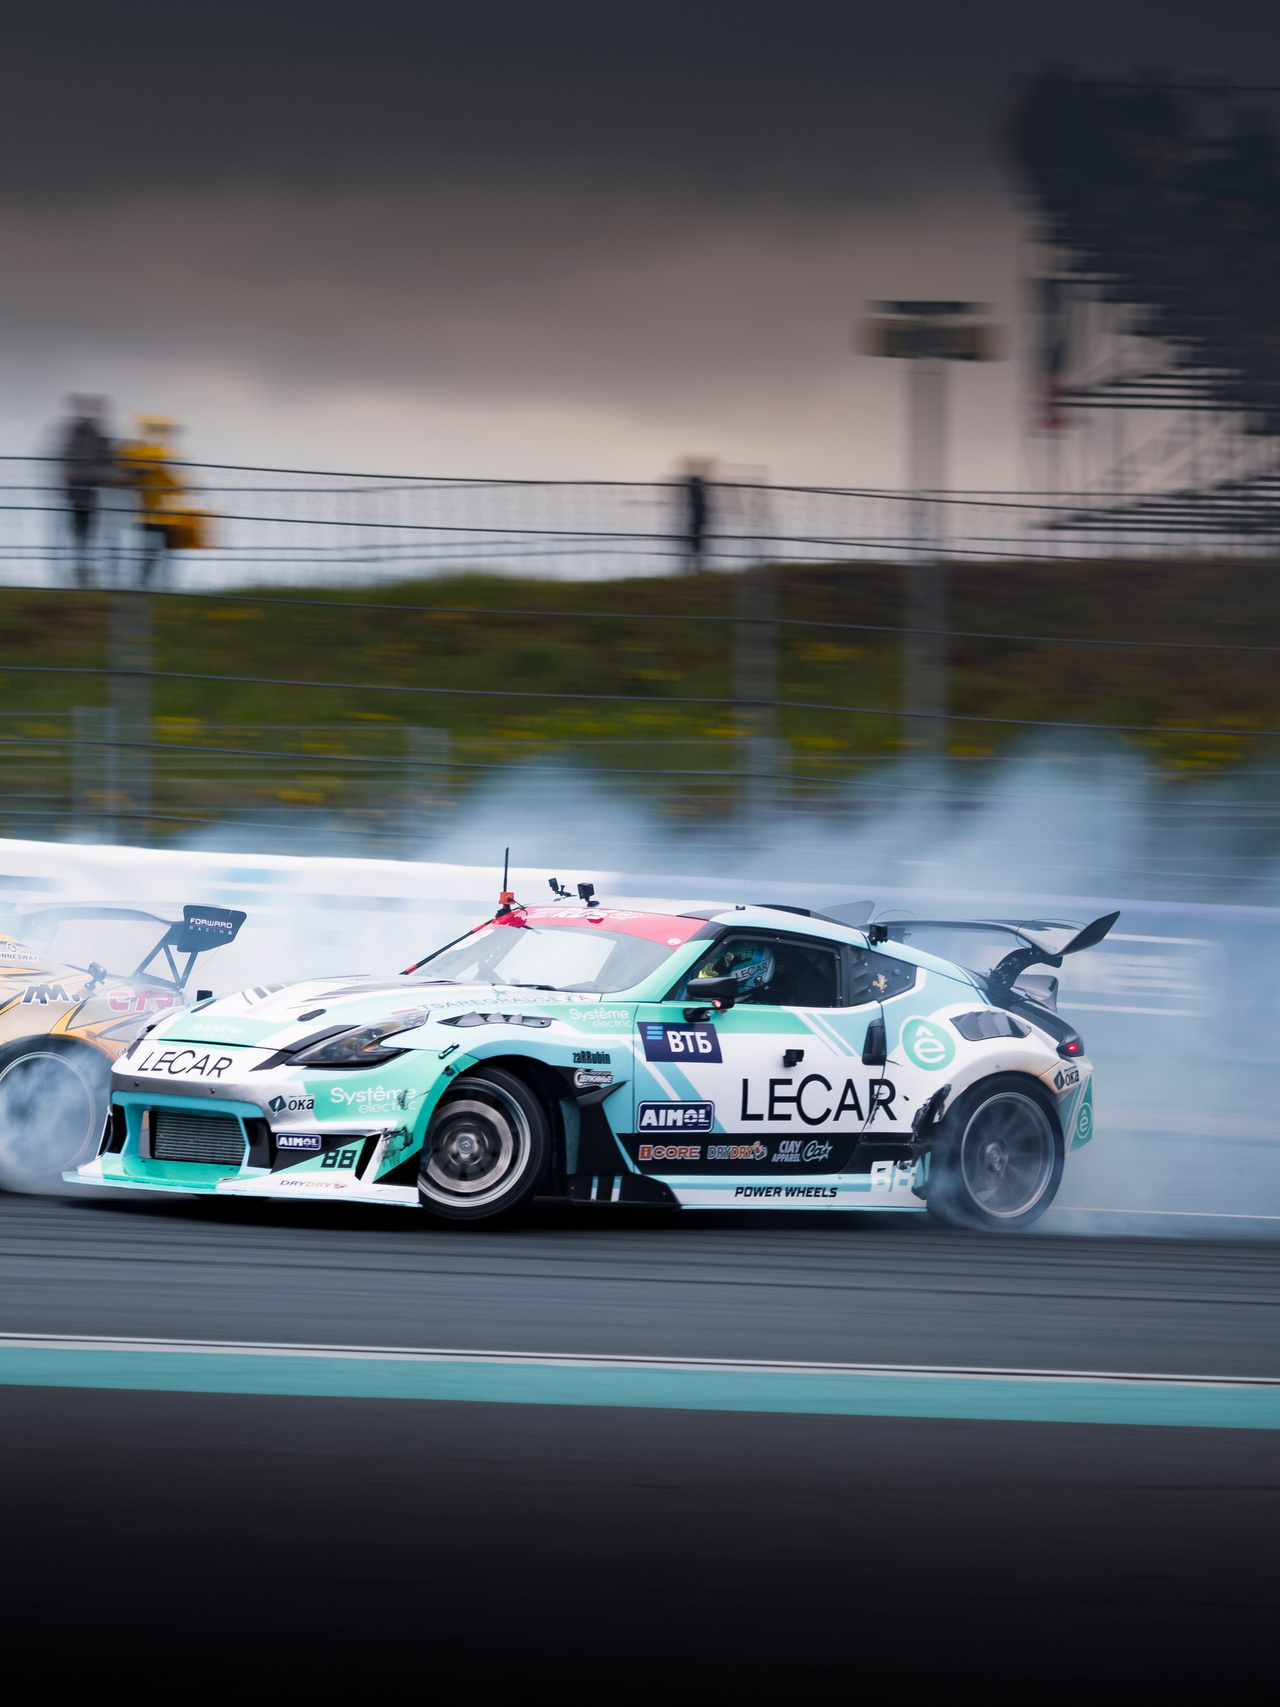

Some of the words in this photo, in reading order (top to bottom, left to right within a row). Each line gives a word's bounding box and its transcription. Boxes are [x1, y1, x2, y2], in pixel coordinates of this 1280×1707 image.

[190, 918, 233, 929] FORWARD
[190, 926, 232, 935] RACING
[735, 962, 769, 979] LECAR
[569, 1007, 630, 1022] Systême
[592, 1018, 632, 1028] electric
[666, 1030, 713, 1054] ВТБ
[137, 1049, 233, 1078] LECAR
[330, 1085, 417, 1105] Systême
[740, 1073, 898, 1126] LECAR
[641, 1108, 710, 1127] AIMOL
[278, 1136, 318, 1147] AIMOL
[321, 1150, 358, 1168] 88
[771, 1153, 801, 1162] APPAREL
[280, 1180, 333, 1188] DRYDRY
[734, 1186, 783, 1197] POWER
[785, 1187, 838, 1198] WHEELS
